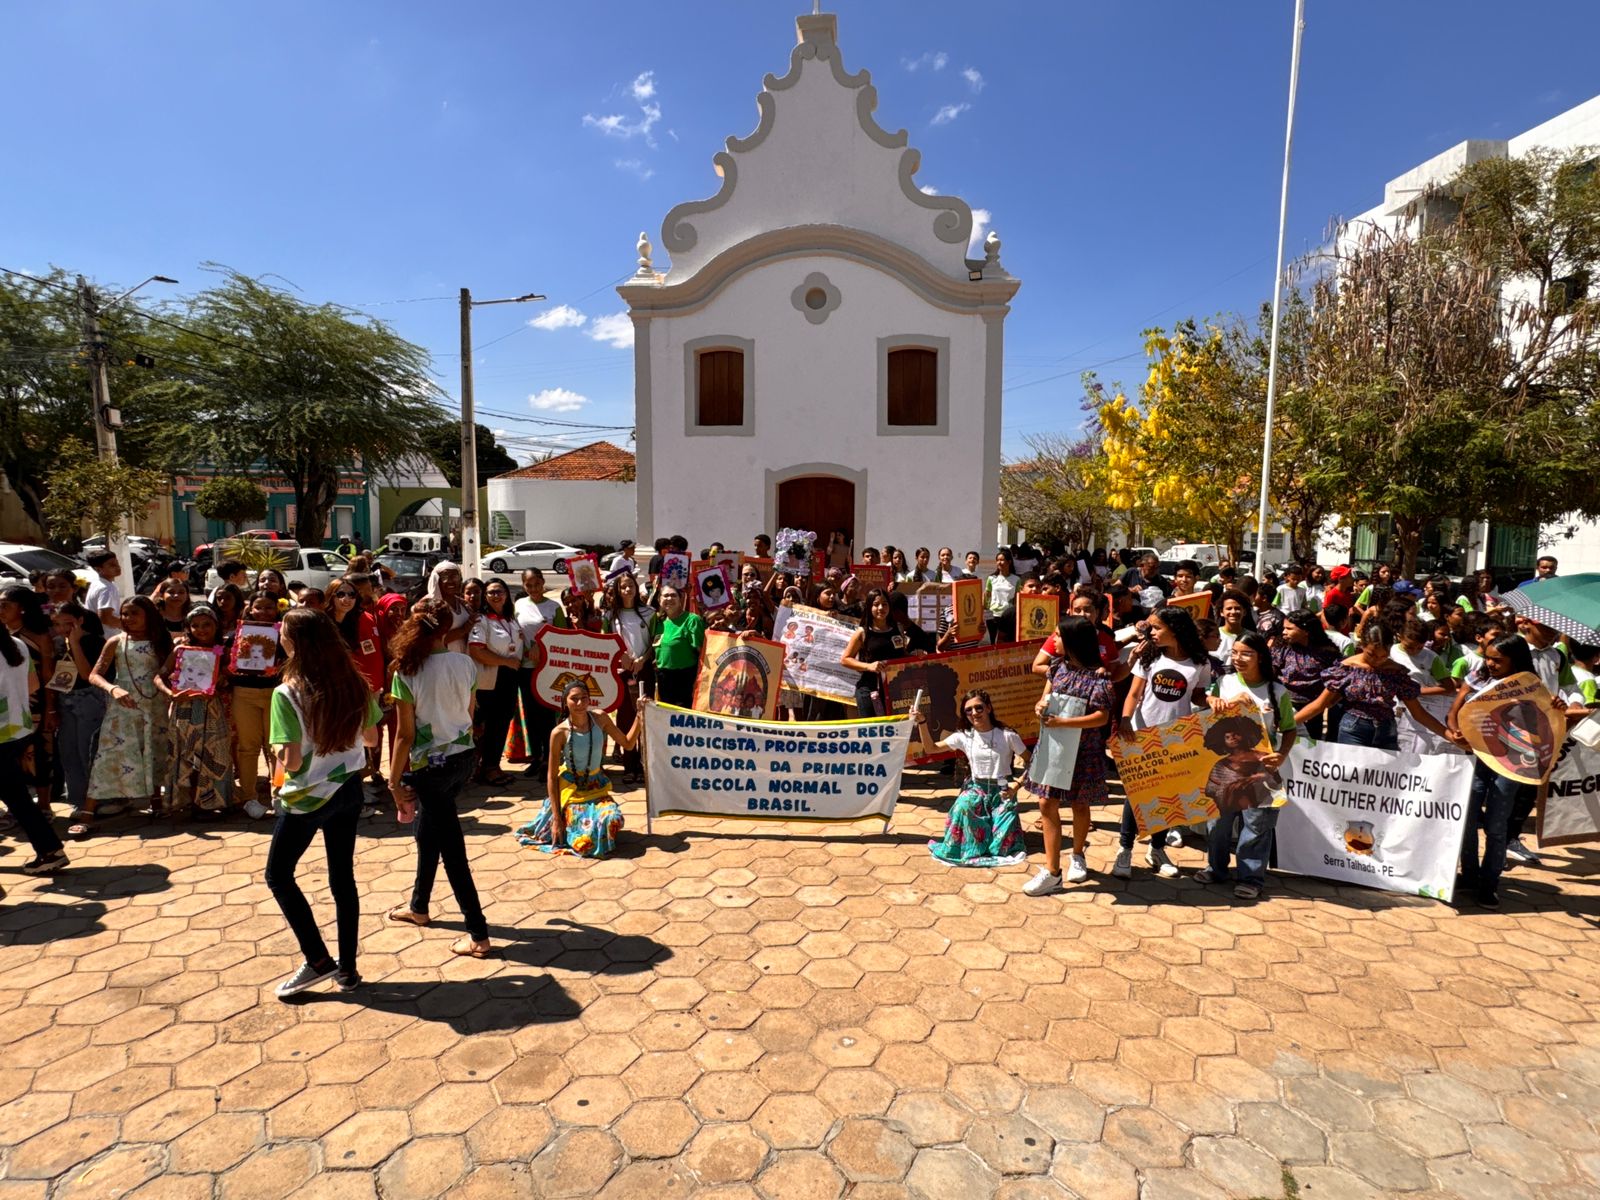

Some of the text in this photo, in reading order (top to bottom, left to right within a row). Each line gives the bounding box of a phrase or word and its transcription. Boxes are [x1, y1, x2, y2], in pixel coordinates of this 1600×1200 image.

[549, 645, 569, 655] ESCOLA
[571, 662, 593, 672] PEREIRA
[968, 664, 1022, 684] CONSCIÊNCIA
[1154, 673, 1175, 687] Sou
[1154, 684, 1182, 697] Martin
[669, 714, 724, 730] MARIA
[817, 730, 849, 739] DOS
[858, 725, 899, 738] REIS:
[667, 733, 891, 755] MUSICISTA, PROFESSORA E
[1169, 749, 1199, 763] MINHA
[670, 756, 887, 777] CRIADORA DA PRIMEIRA
[1302, 759, 1433, 793] ESCOLA MUNICIPAL
[691, 777, 879, 795] ESCOLA NORMAL DO
[747, 797, 817, 812] BRASIL.
[1320, 786, 1376, 812] LUTHER
[1379, 796, 1414, 817] KING
[1414, 800, 1464, 821] JUNIO
[1323, 854, 1345, 868] Serra
[1346, 857, 1376, 874] Talhada
[1382, 865, 1394, 877] PE
